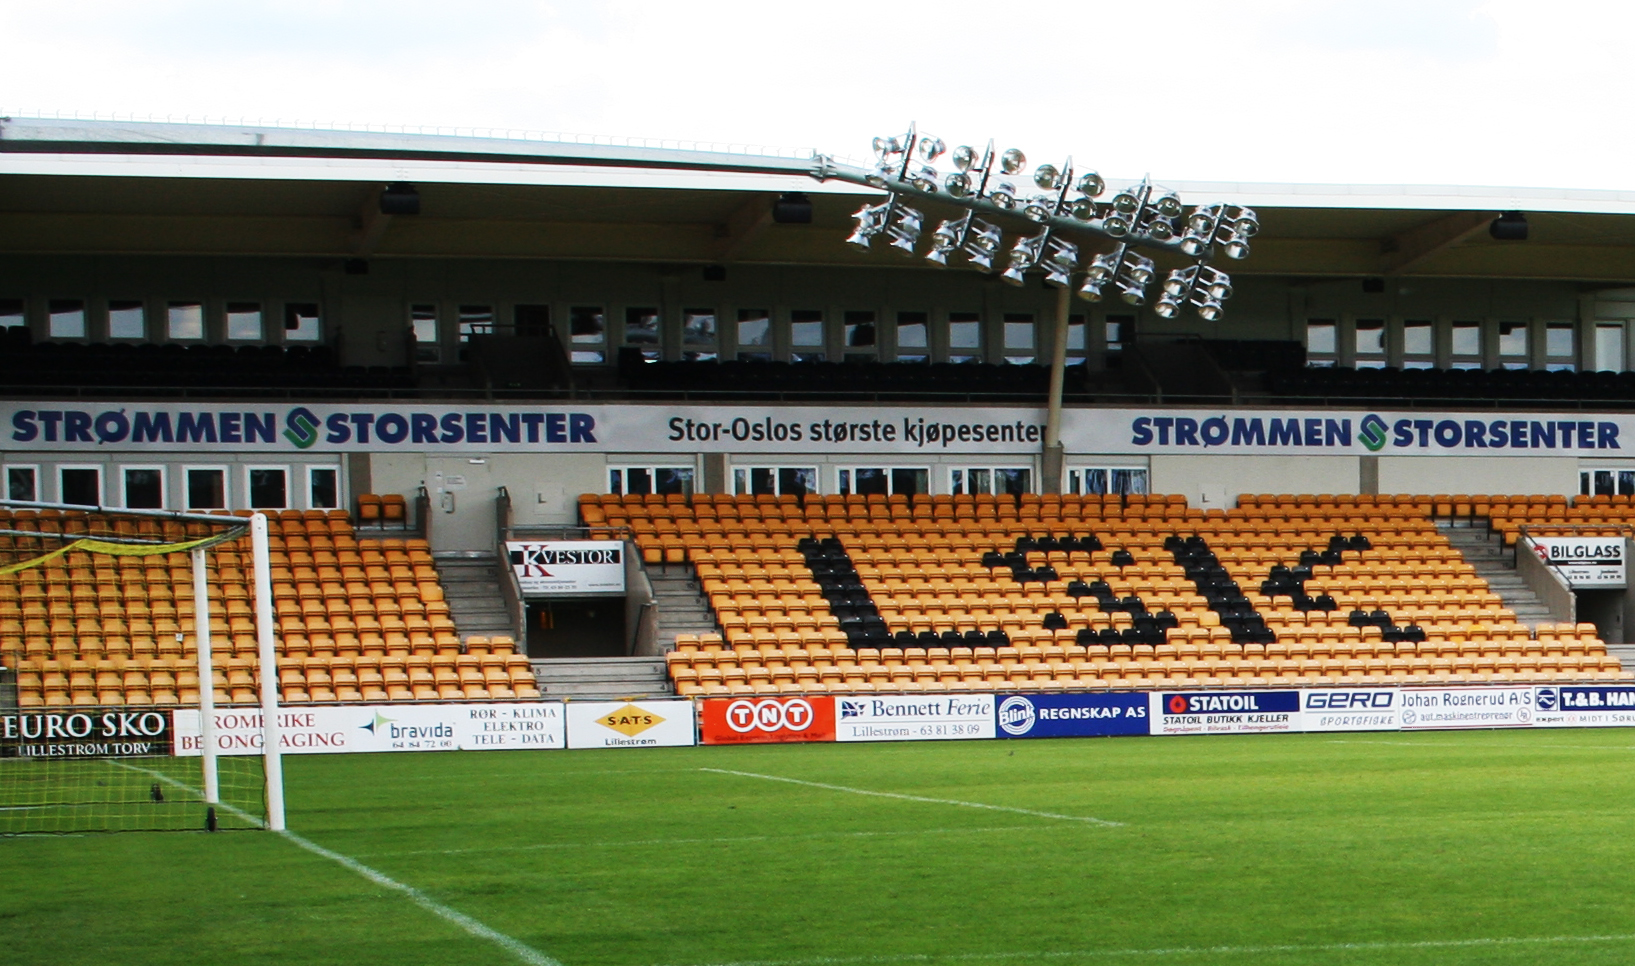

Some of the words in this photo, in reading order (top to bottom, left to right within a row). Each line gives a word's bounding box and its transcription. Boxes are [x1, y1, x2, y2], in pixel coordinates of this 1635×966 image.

[12, 408, 276, 445] STRØMMEN
[326, 412, 598, 444] STORSENTER
[668, 416, 802, 442] Stor-Oslos
[809, 418, 896, 444] største
[904, 417, 1048, 448] kjøpesenter
[1132, 414, 1352, 448] STRØMMEN
[1393, 419, 1621, 449] STORSENTER
[1551, 545, 1621, 559] BILGLASS
[519, 545, 614, 577] KVESTOR
[797, 535, 1426, 650] LSK
[871, 699, 941, 717] Bennett
[946, 698, 990, 716] Ferie
[1189, 695, 1259, 712] STATOIL
[1401, 693, 1438, 707] Johan
[1443, 692, 1504, 706] Rognerud
[1509, 691, 1532, 705] A/S
[470, 709, 497, 720] RØR
[513, 708, 557, 719] KLIMA
[1000, 705, 1036, 726] Blink
[1039, 707, 1121, 720] REGNSKAP
[1125, 706, 1146, 718] AS
[1163, 715, 1202, 725] STATOIL
[1206, 715, 1243, 724] BUTIKK
[1247, 714, 1289, 723] KJELLER
[2, 713, 93, 739] EURO
[102, 712, 165, 737] SKO
[391, 722, 453, 739] bravida
[484, 721, 544, 732] ELEKTRO
[852, 725, 910, 737] Lillestrøm
[920, 725, 933, 736] 63
[936, 725, 947, 735] 81
[967, 724, 980, 735] 09
[472, 734, 506, 745] TELE
[522, 733, 555, 744] DATA
[112, 742, 151, 755] TORV
